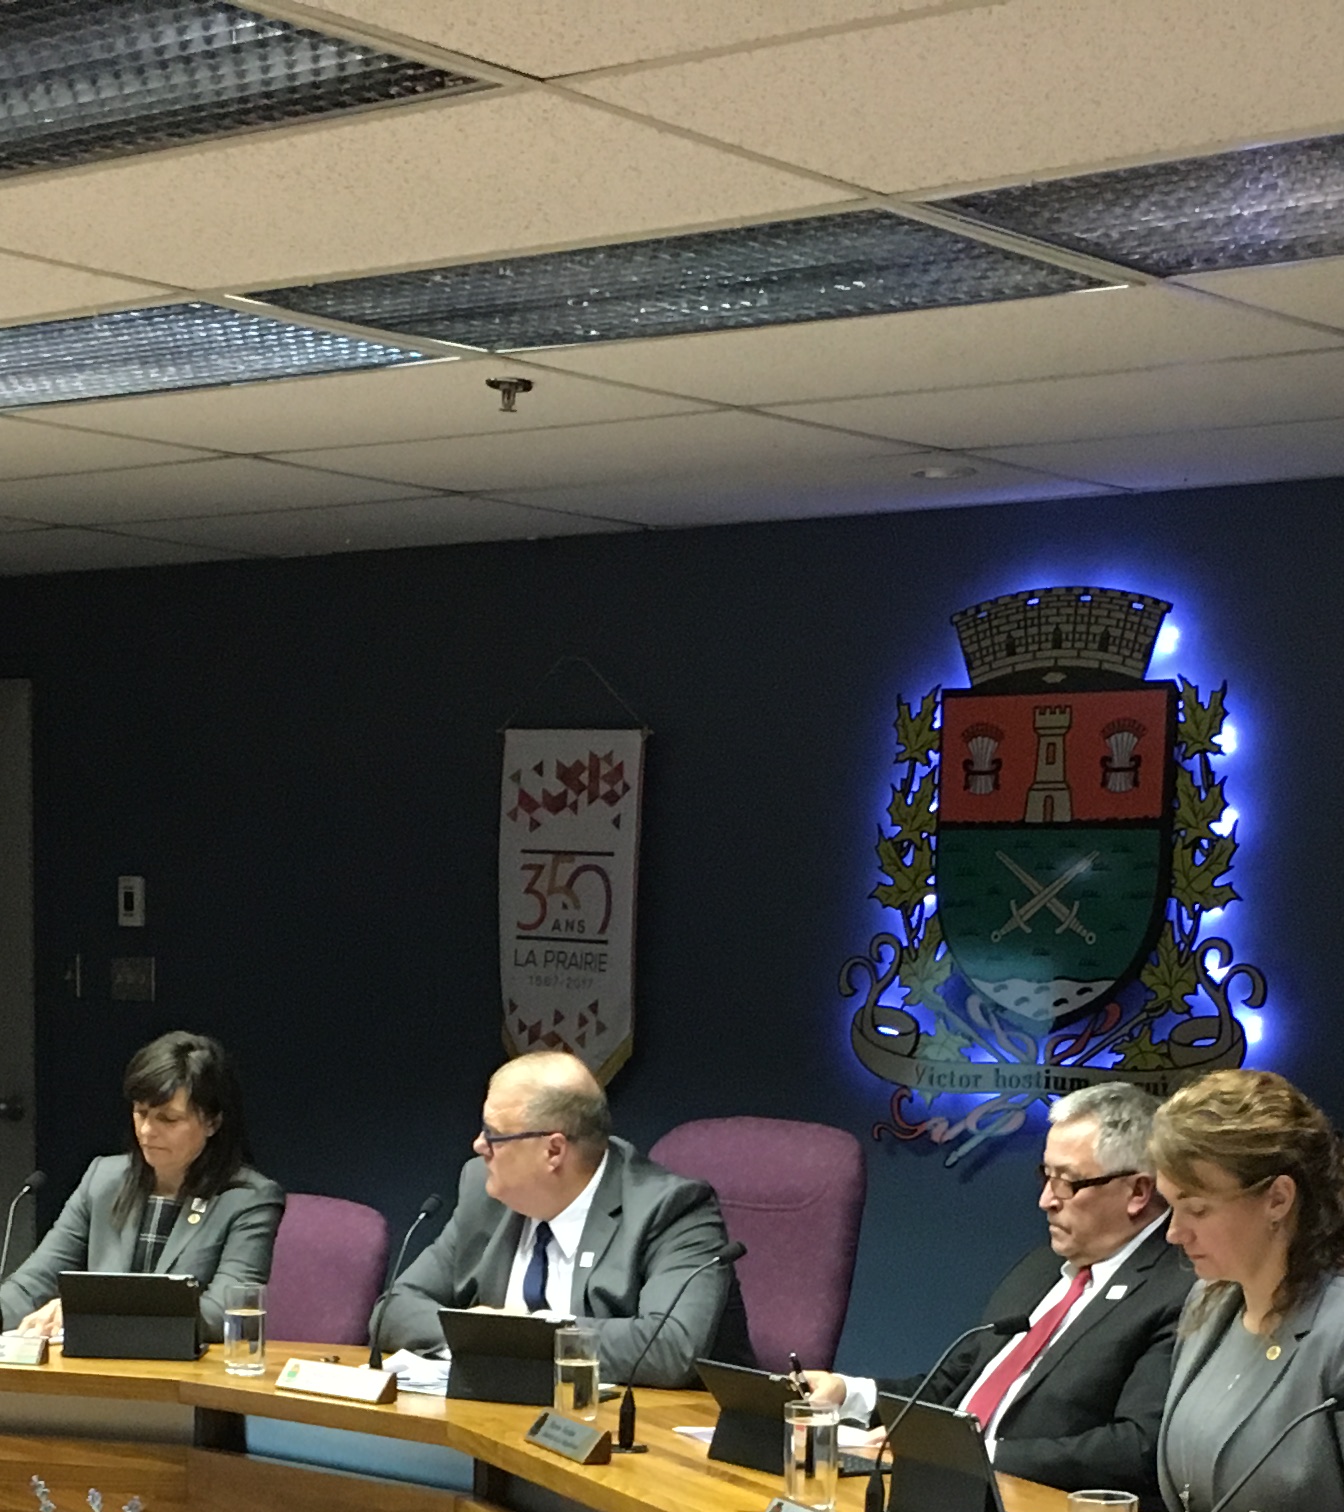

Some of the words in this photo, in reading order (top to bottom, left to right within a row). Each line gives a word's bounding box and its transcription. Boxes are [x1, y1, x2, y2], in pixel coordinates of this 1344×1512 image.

[517, 854, 613, 935] 350
[552, 918, 587, 934] ANS
[513, 948, 538, 968] LA
[543, 950, 608, 973] PRAIRIE
[915, 1064, 983, 1089] Victor
